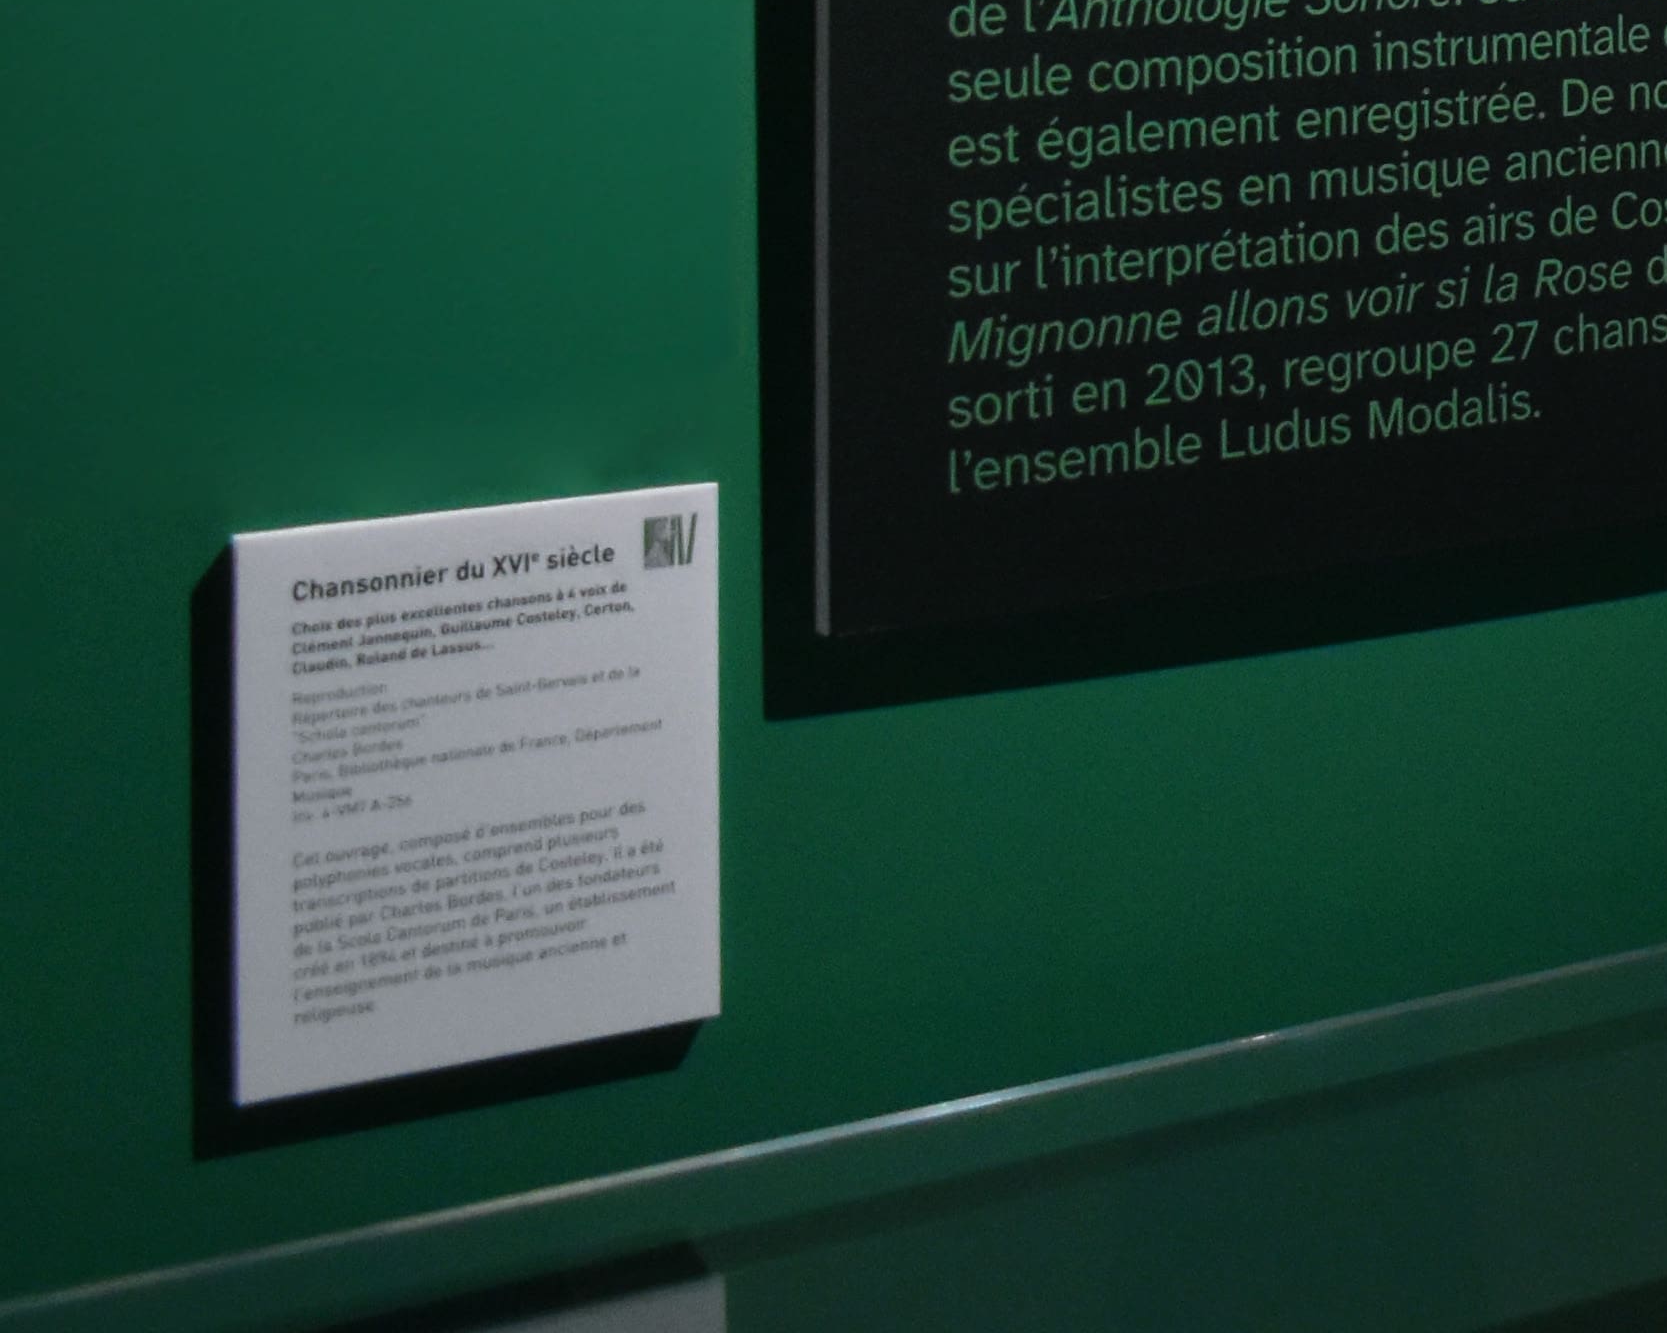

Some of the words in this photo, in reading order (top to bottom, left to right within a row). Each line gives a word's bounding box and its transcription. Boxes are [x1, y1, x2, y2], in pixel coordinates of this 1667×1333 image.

[947, 173, 1224, 241] spécialistes
[1238, 171, 1292, 208] en
[1309, 148, 1491, 201] musique
[948, 422, 1204, 494] l'ensemble
[1219, 406, 1353, 461] Ludus
[1367, 380, 1542, 441] Modalis.
[291, 566, 449, 603] Chansonnier
[455, 559, 485, 582] du
[546, 543, 615, 571] siècle
